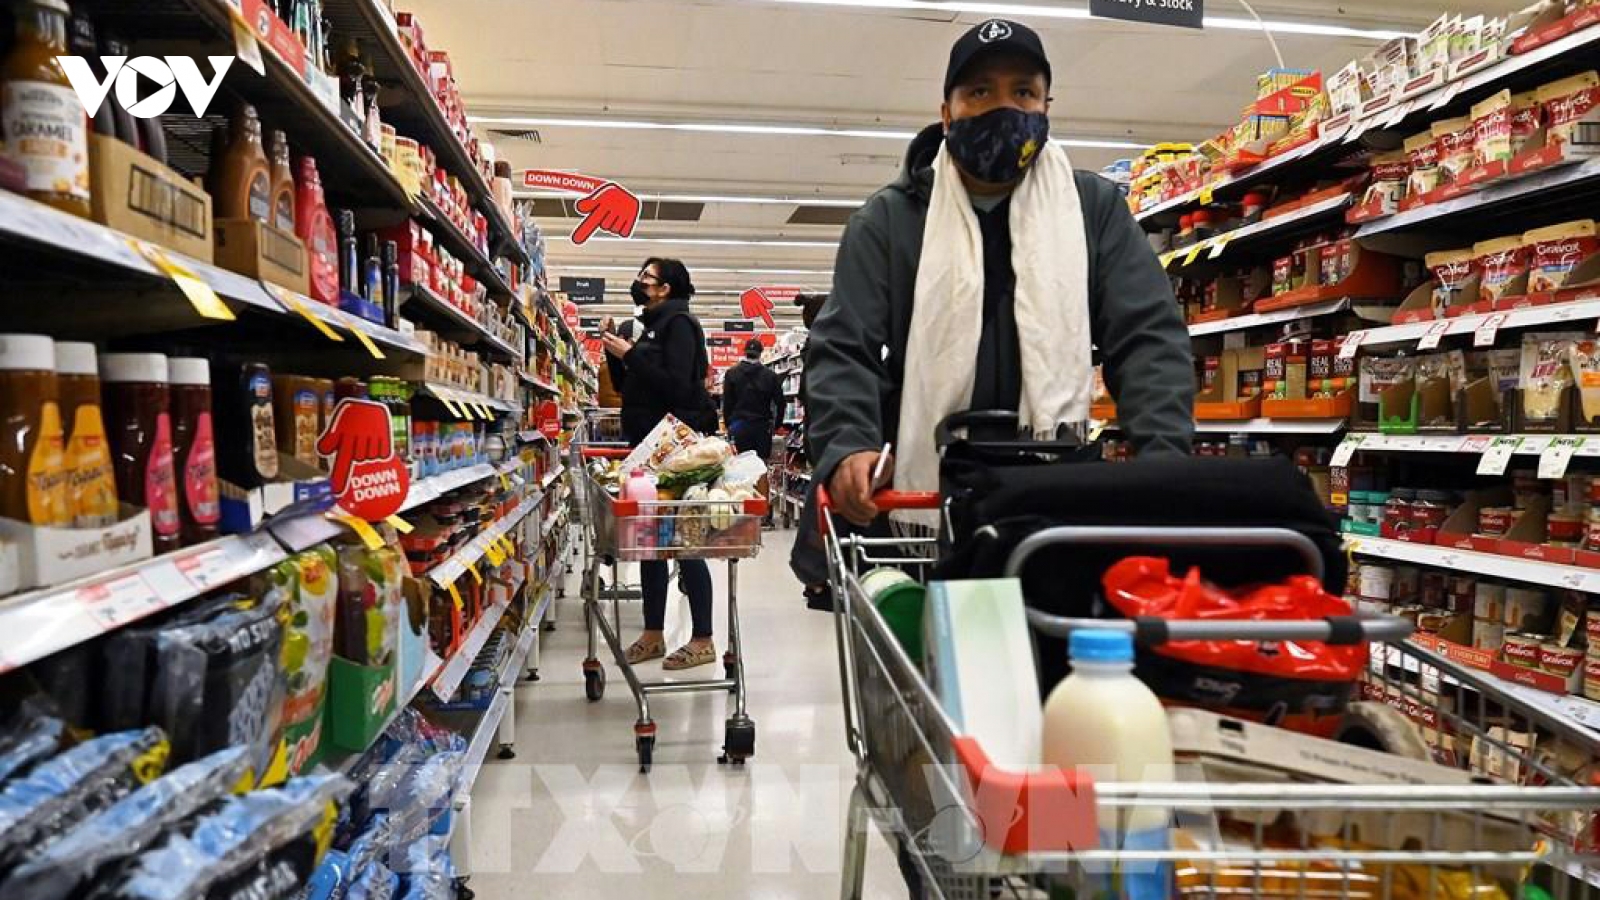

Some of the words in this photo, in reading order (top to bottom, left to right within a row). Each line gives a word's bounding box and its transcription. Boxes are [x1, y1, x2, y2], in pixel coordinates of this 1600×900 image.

[1159, 0, 1193, 11] Stock
[527, 174, 561, 186] DOWN
[562, 178, 595, 190] DOWN
[1537, 242, 1581, 255] Gravox
[351, 469, 397, 489] DOWN
[354, 481, 400, 502] DOWN
[1505, 642, 1535, 658] Gravox
[1542, 652, 1574, 667] Gravox
